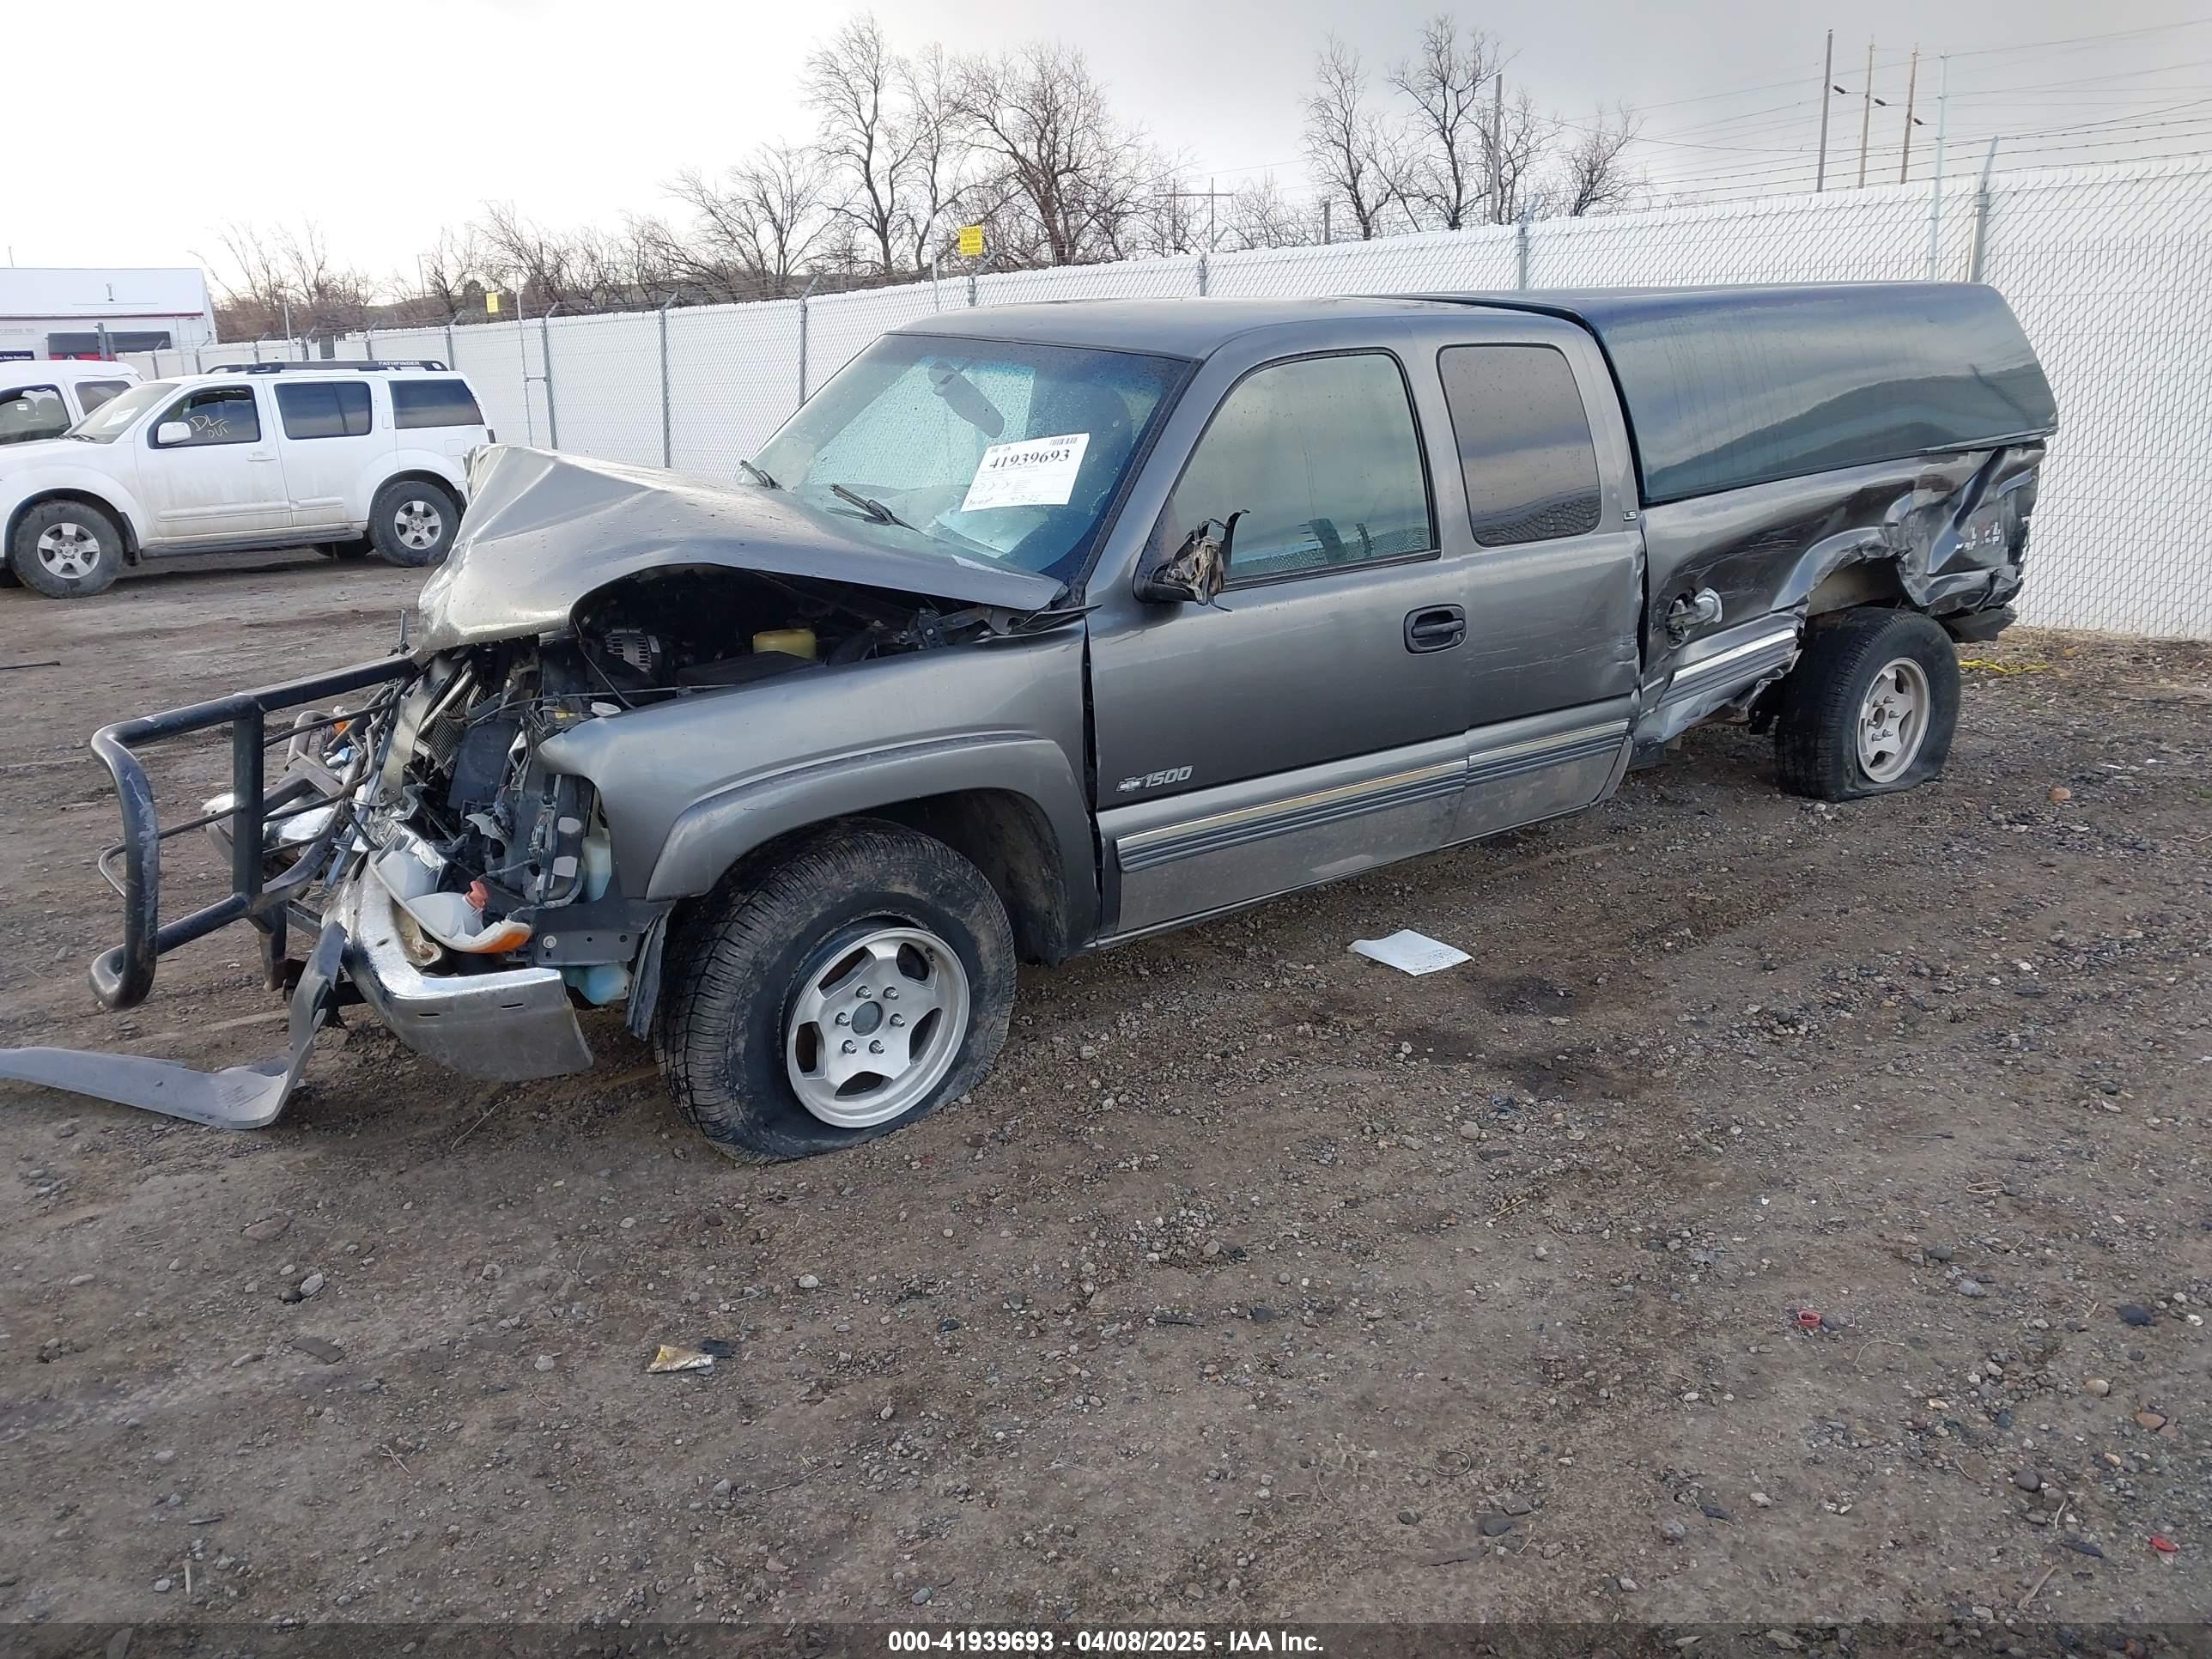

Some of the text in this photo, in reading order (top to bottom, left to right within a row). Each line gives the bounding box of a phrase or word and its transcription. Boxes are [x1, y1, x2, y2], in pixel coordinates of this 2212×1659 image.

[989, 448, 1070, 469] 41939693
[1624, 511, 1637, 520] LS
[1145, 765, 1194, 788] 1500
